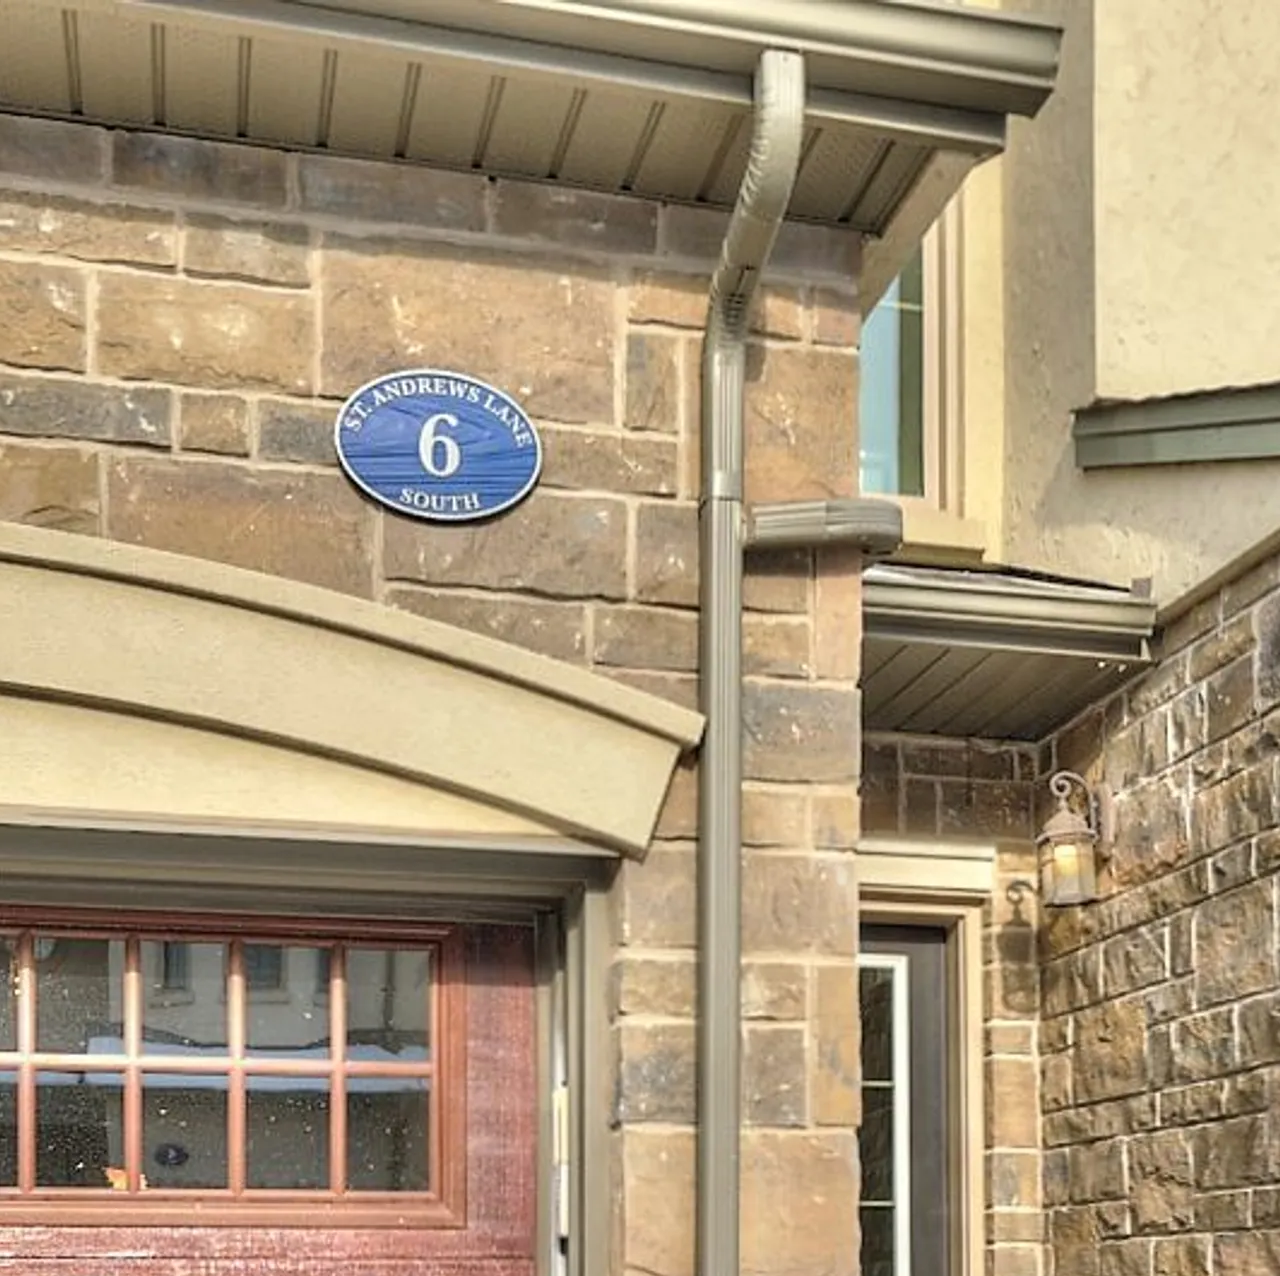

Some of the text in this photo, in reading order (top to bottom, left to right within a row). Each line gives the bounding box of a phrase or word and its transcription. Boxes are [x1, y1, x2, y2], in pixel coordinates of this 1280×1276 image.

[345, 377, 533, 448] ST. ANDREWS LANE
[418, 413, 462, 478] 6
[399, 487, 481, 512] SOUTH
